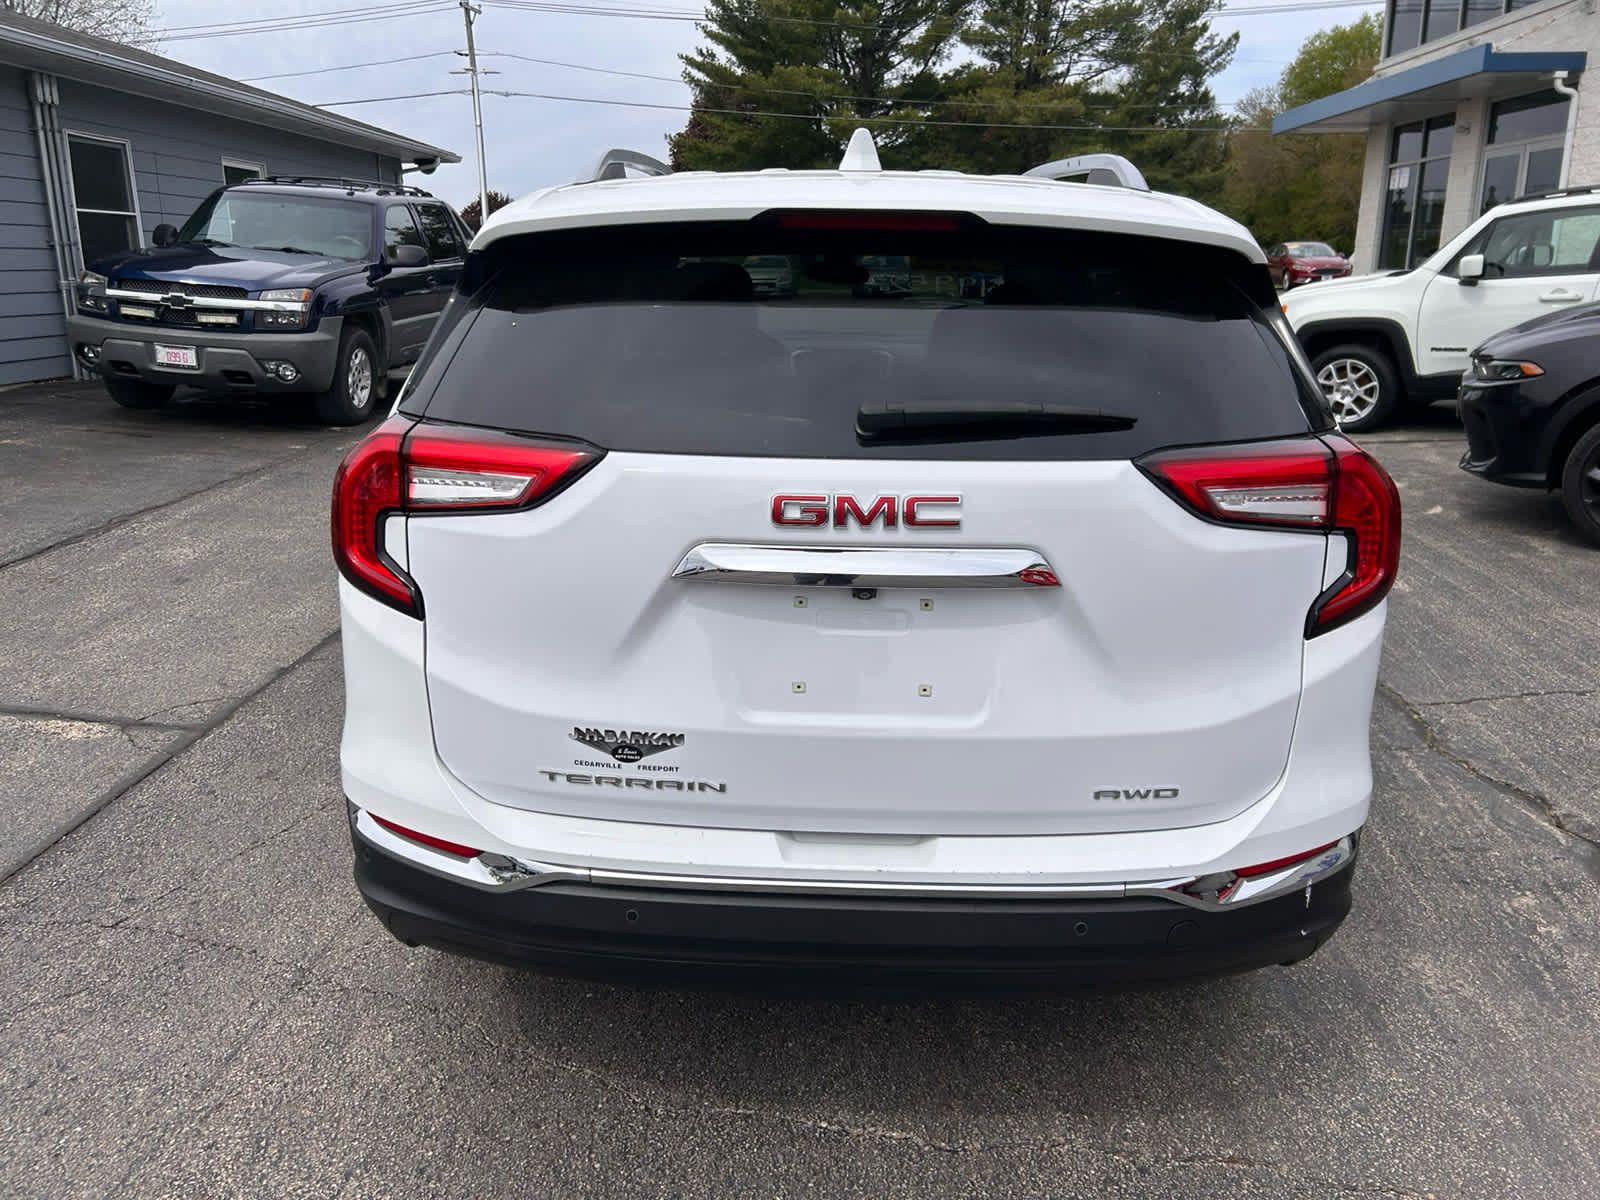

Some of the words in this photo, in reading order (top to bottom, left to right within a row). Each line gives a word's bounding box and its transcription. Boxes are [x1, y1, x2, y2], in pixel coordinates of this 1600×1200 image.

[771, 493, 963, 528] GMC
[574, 759, 622, 770] CEDARVILLE
[637, 764, 680, 773] FREEPORT
[538, 770, 728, 793] TERRAIN
[1093, 788, 1180, 801] AWD
